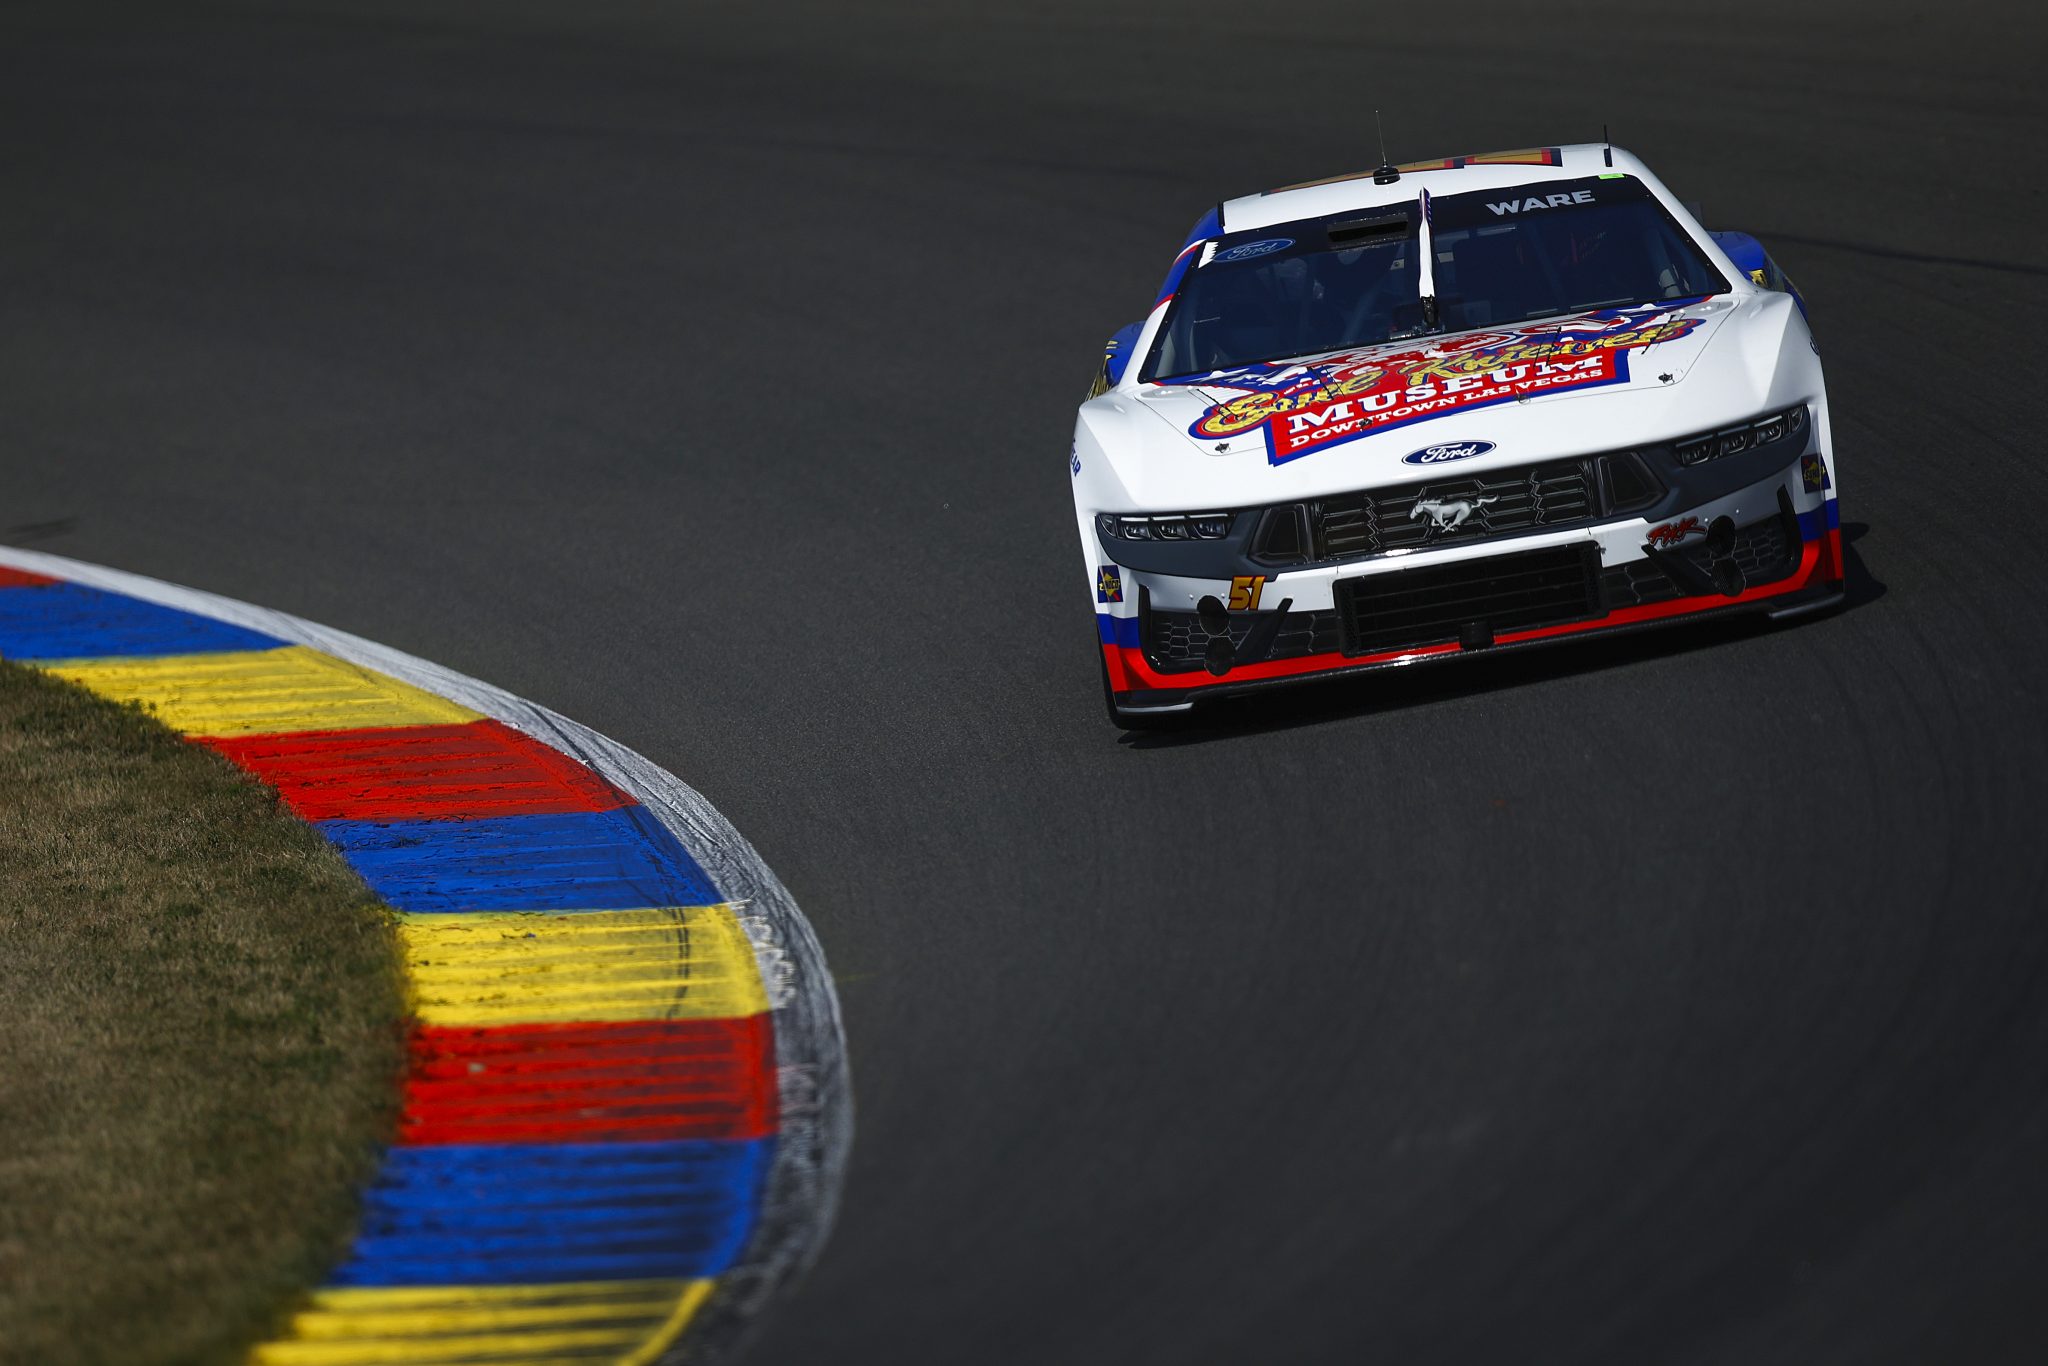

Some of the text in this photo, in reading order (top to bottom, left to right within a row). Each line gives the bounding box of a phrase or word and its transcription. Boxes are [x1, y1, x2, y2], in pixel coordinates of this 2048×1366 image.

[1485, 189, 1596, 216] WARE
[1288, 355, 1603, 435] MUSEUM
[1463, 385, 1512, 401] LAS
[1515, 369, 1603, 390] VEGAS
[1227, 575, 1267, 611] 51
